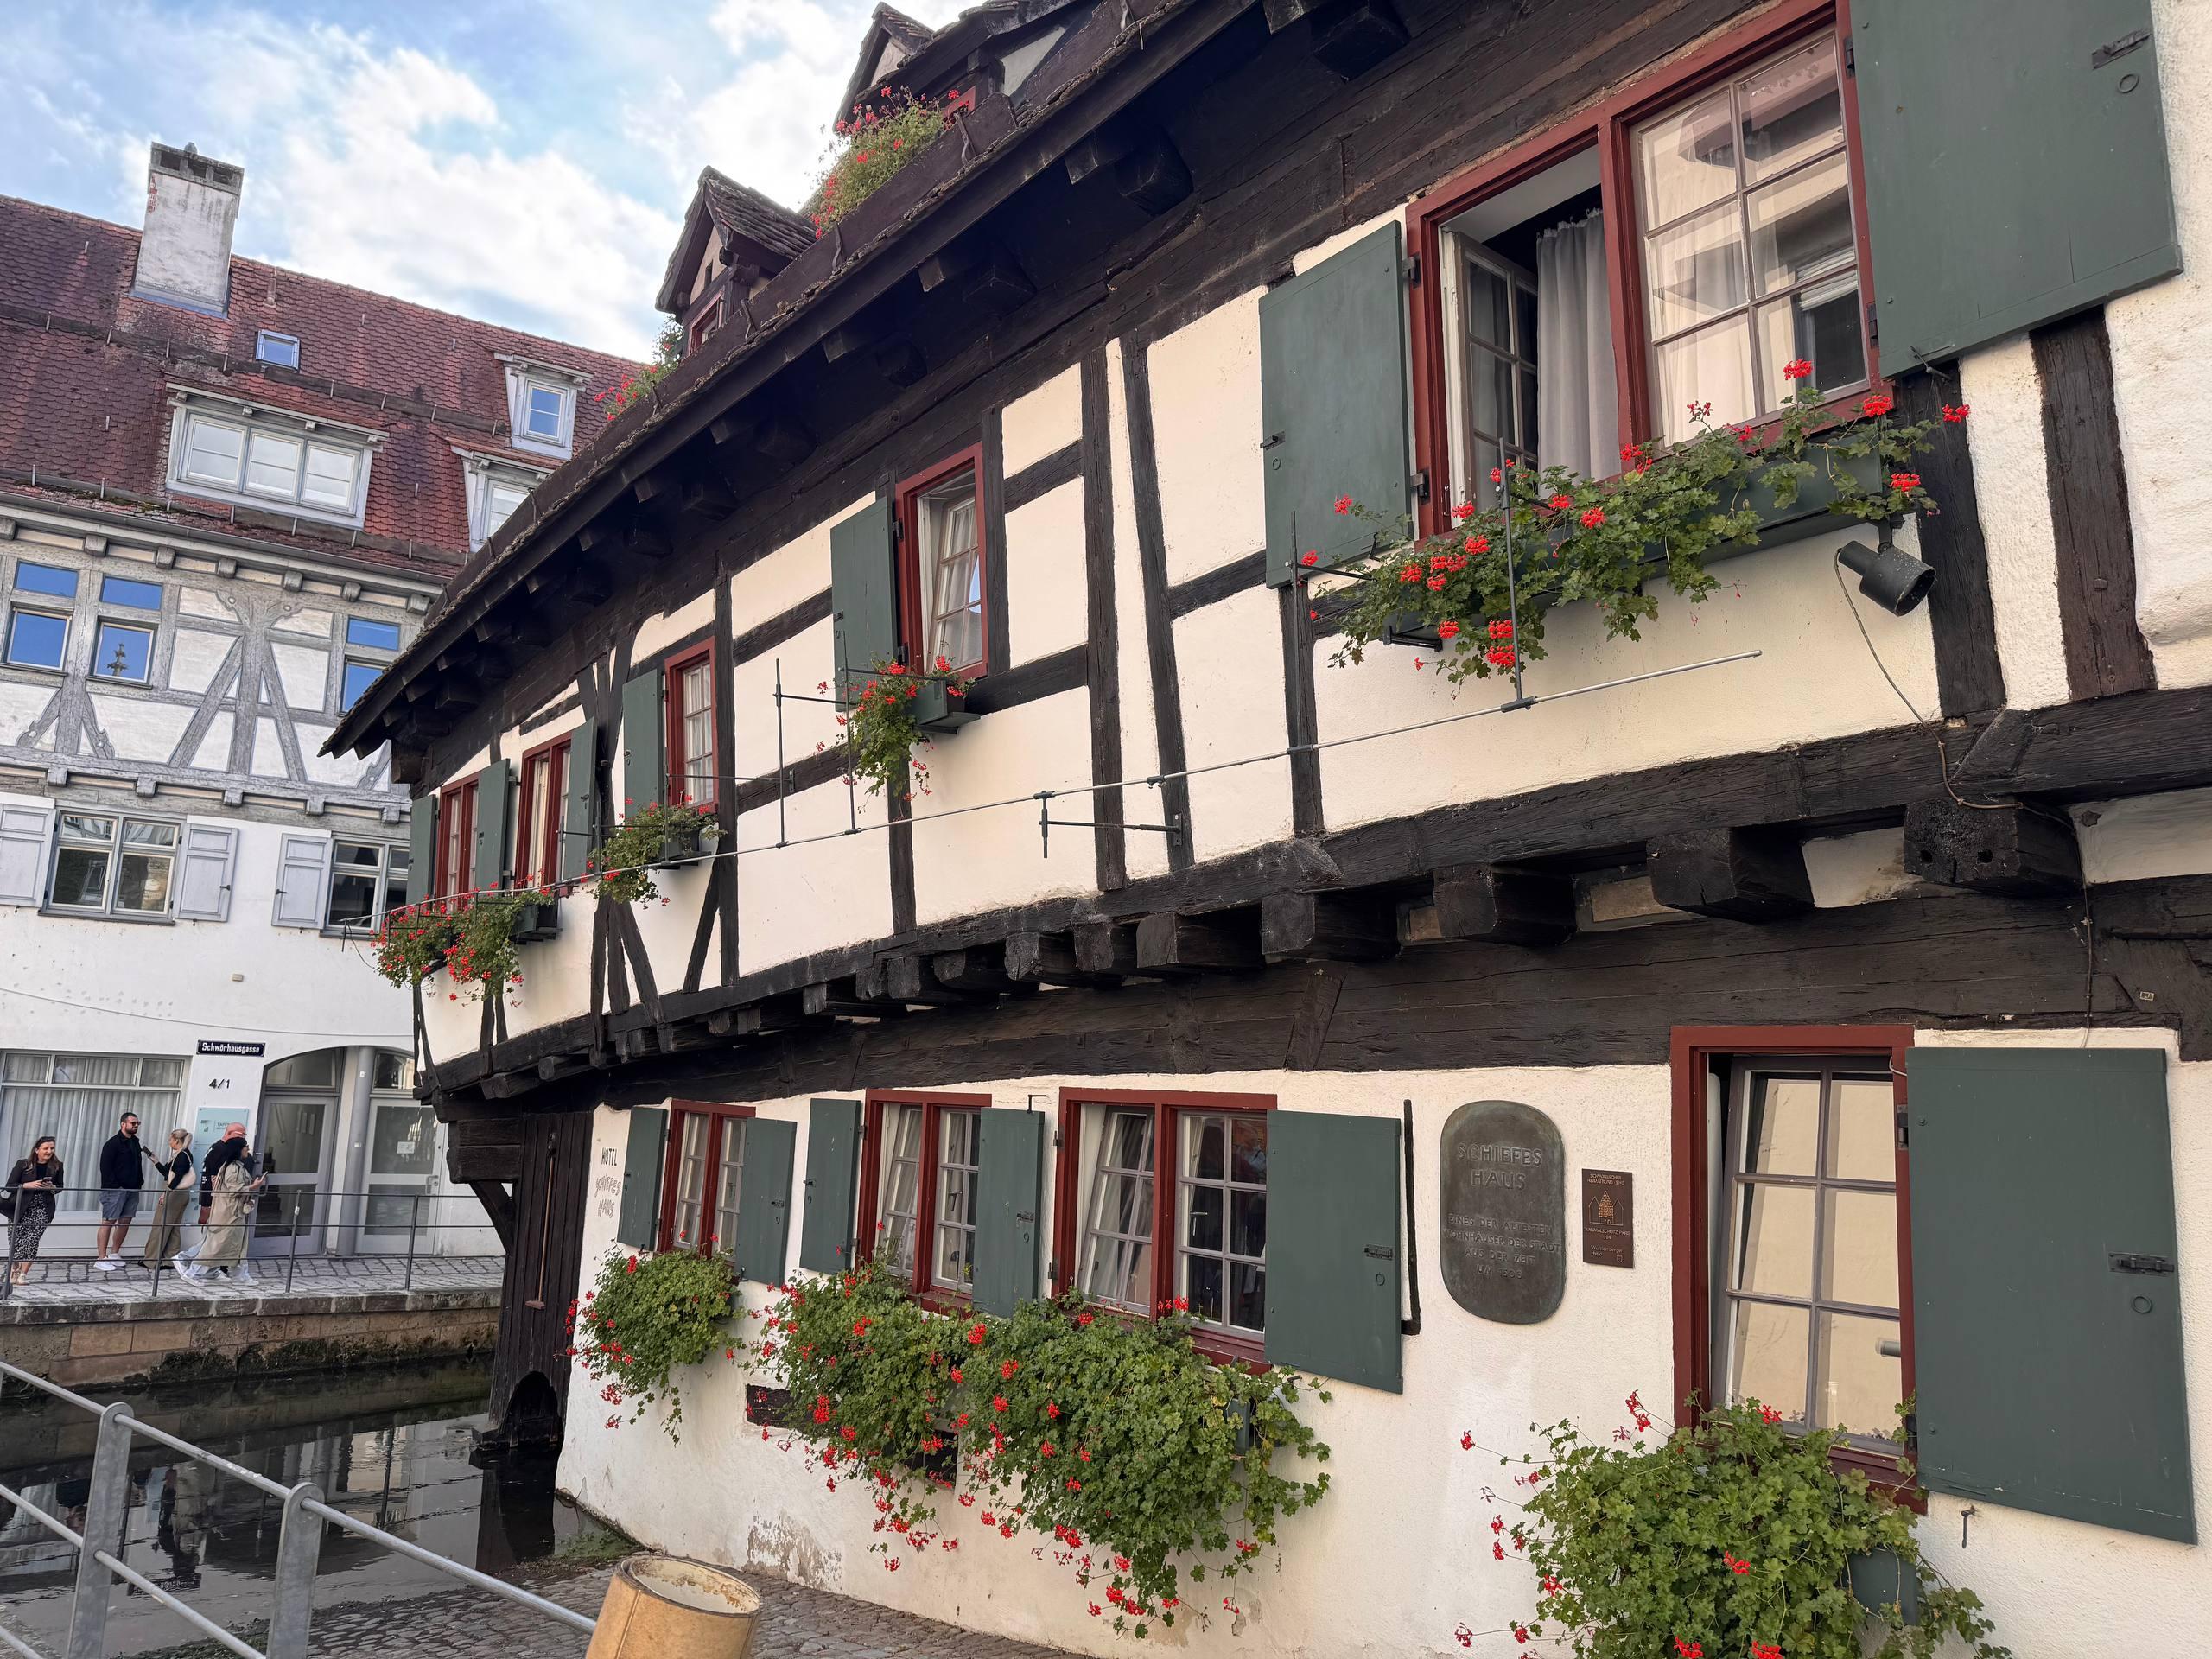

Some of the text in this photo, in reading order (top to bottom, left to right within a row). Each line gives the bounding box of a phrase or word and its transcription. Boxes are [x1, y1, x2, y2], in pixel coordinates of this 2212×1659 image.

[202, 1042, 260, 1054] Schwörhausgasse
[209, 1078, 230, 1089] 4/1
[601, 1147, 617, 1166] HOTEL
[1458, 1143, 1542, 1167] SCHIEFES
[1471, 1169, 1526, 1190] HAUS
[1448, 1213, 1474, 1226] EINES
[1479, 1217, 1498, 1229] DER
[1507, 1236, 1528, 1249] DER
[1529, 1239, 1562, 1253] STADT
[1465, 1248, 1535, 1265] AUS DER ZEIT
